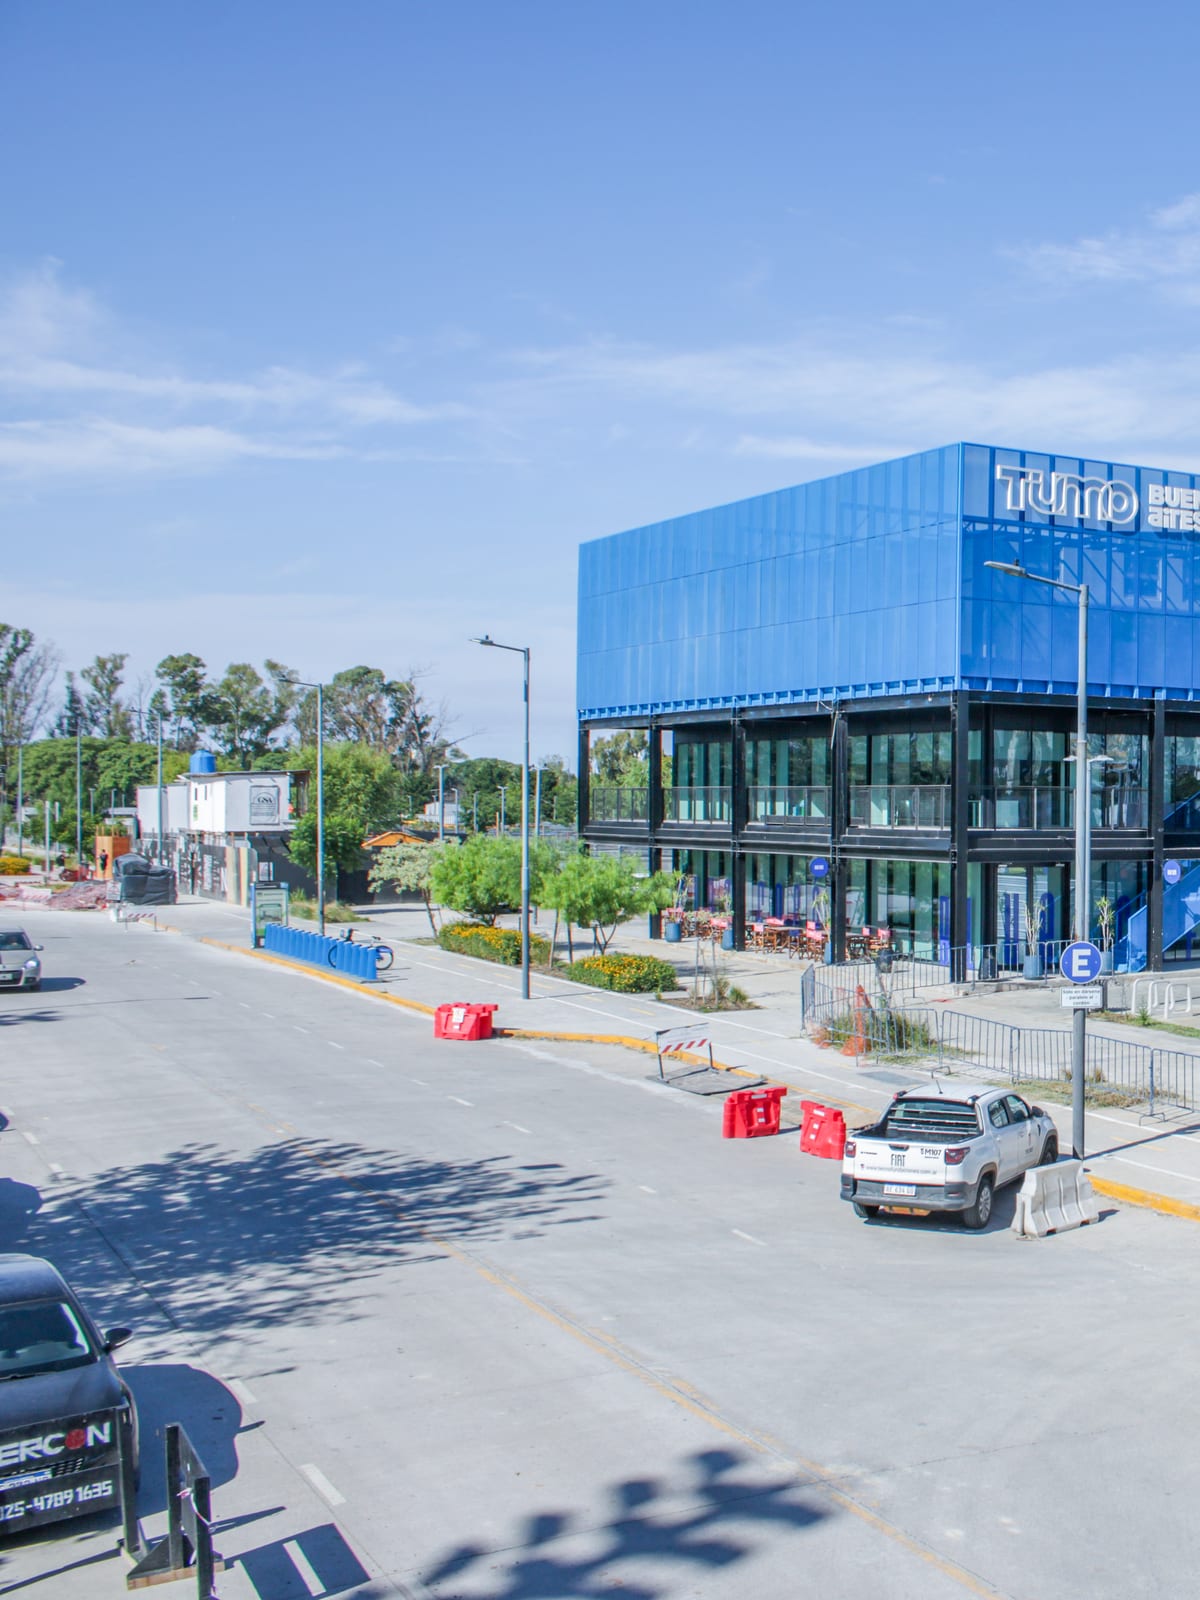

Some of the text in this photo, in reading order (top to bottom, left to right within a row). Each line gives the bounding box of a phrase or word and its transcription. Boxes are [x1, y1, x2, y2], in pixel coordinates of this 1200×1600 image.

[1072, 948, 1091, 977] E
[891, 1153, 906, 1167] FIAT
[75, 1480, 113, 1502] 1635
